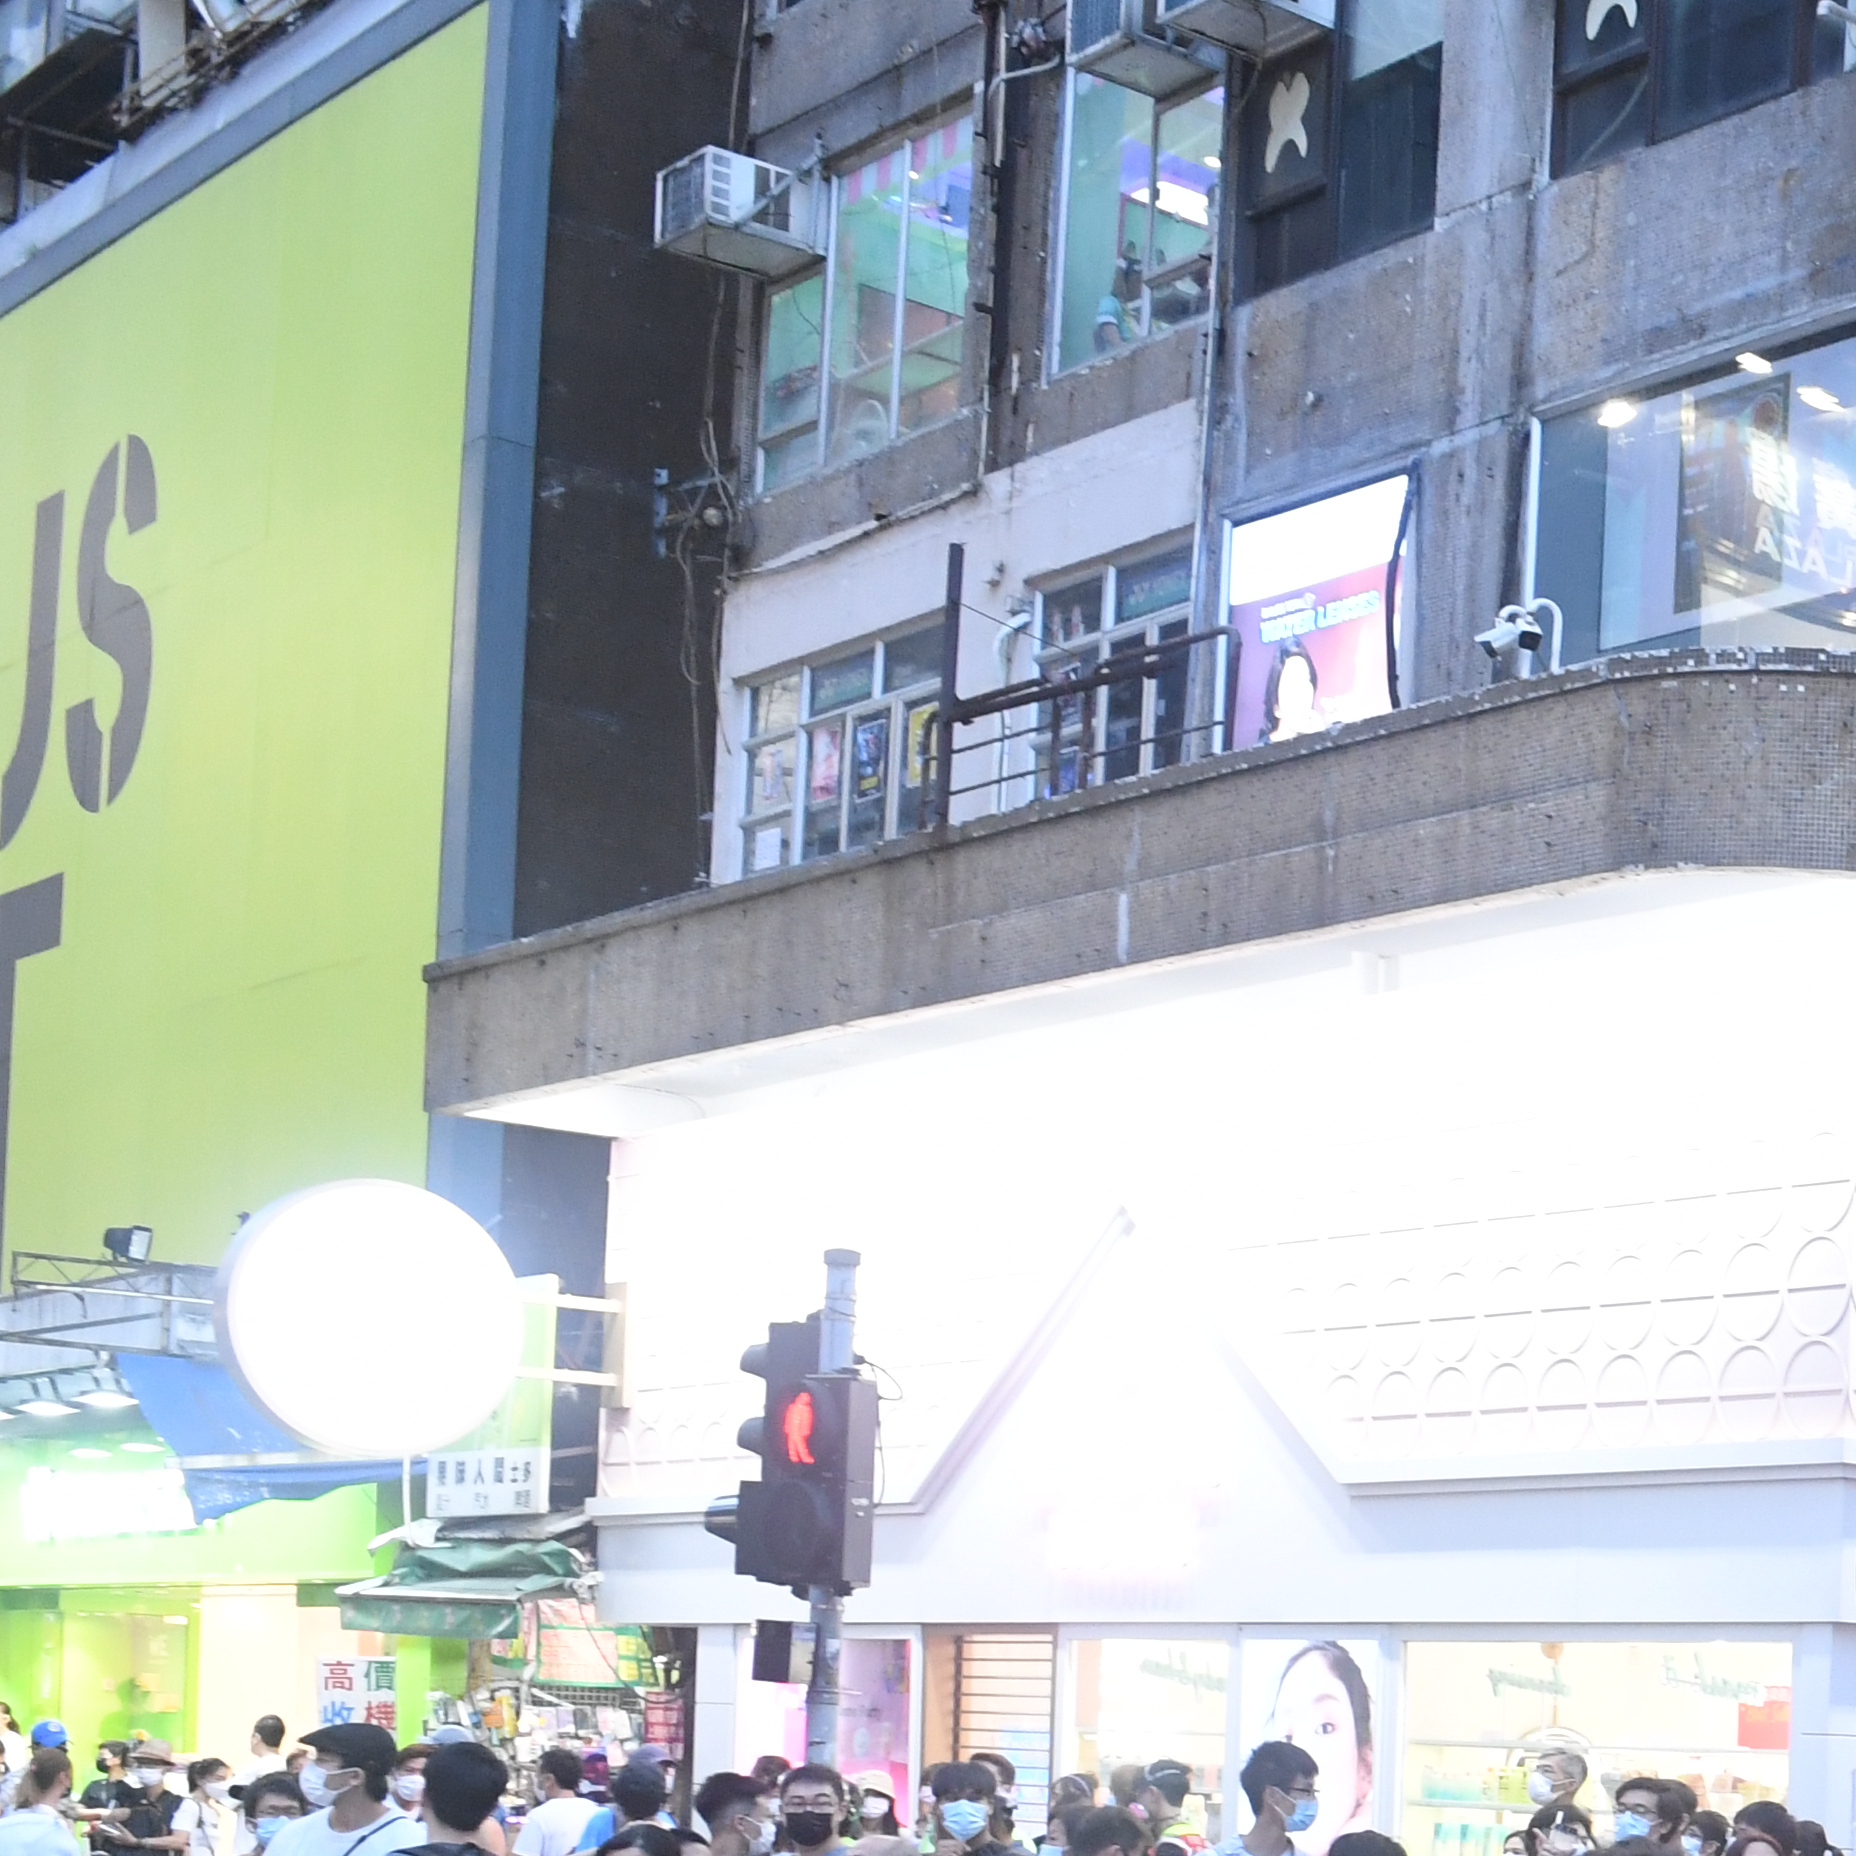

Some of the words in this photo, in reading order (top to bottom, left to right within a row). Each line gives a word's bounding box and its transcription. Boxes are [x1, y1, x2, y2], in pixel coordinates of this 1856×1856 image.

[1260, 610, 1315, 643] WATER
[1316, 590, 1380, 629] LENSES
[322, 1660, 397, 1692] 高價
